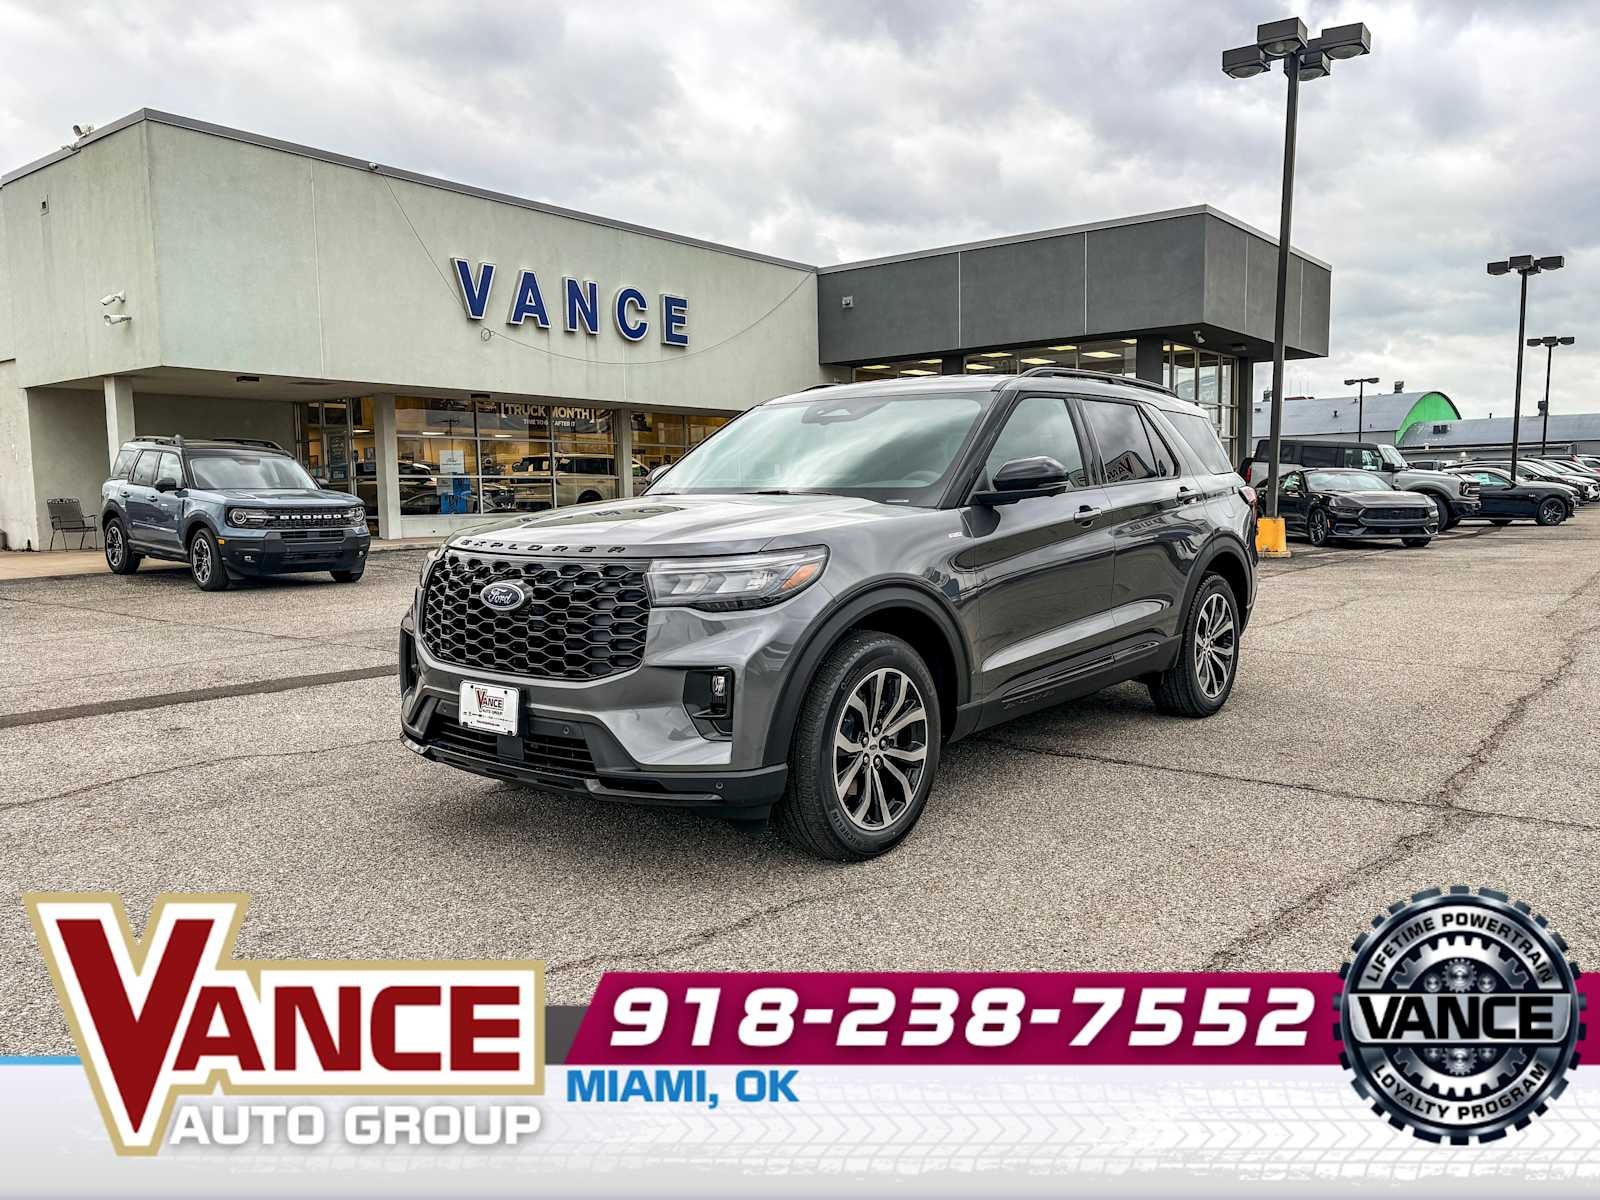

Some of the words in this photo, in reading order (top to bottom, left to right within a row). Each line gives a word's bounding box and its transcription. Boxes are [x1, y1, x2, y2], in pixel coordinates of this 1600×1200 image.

[450, 257, 689, 347] VANCE
[505, 403, 546, 417] TRUCK
[461, 539, 626, 553] EXPLORER
[487, 587, 513, 605] Ford
[476, 689, 504, 710] VANCE
